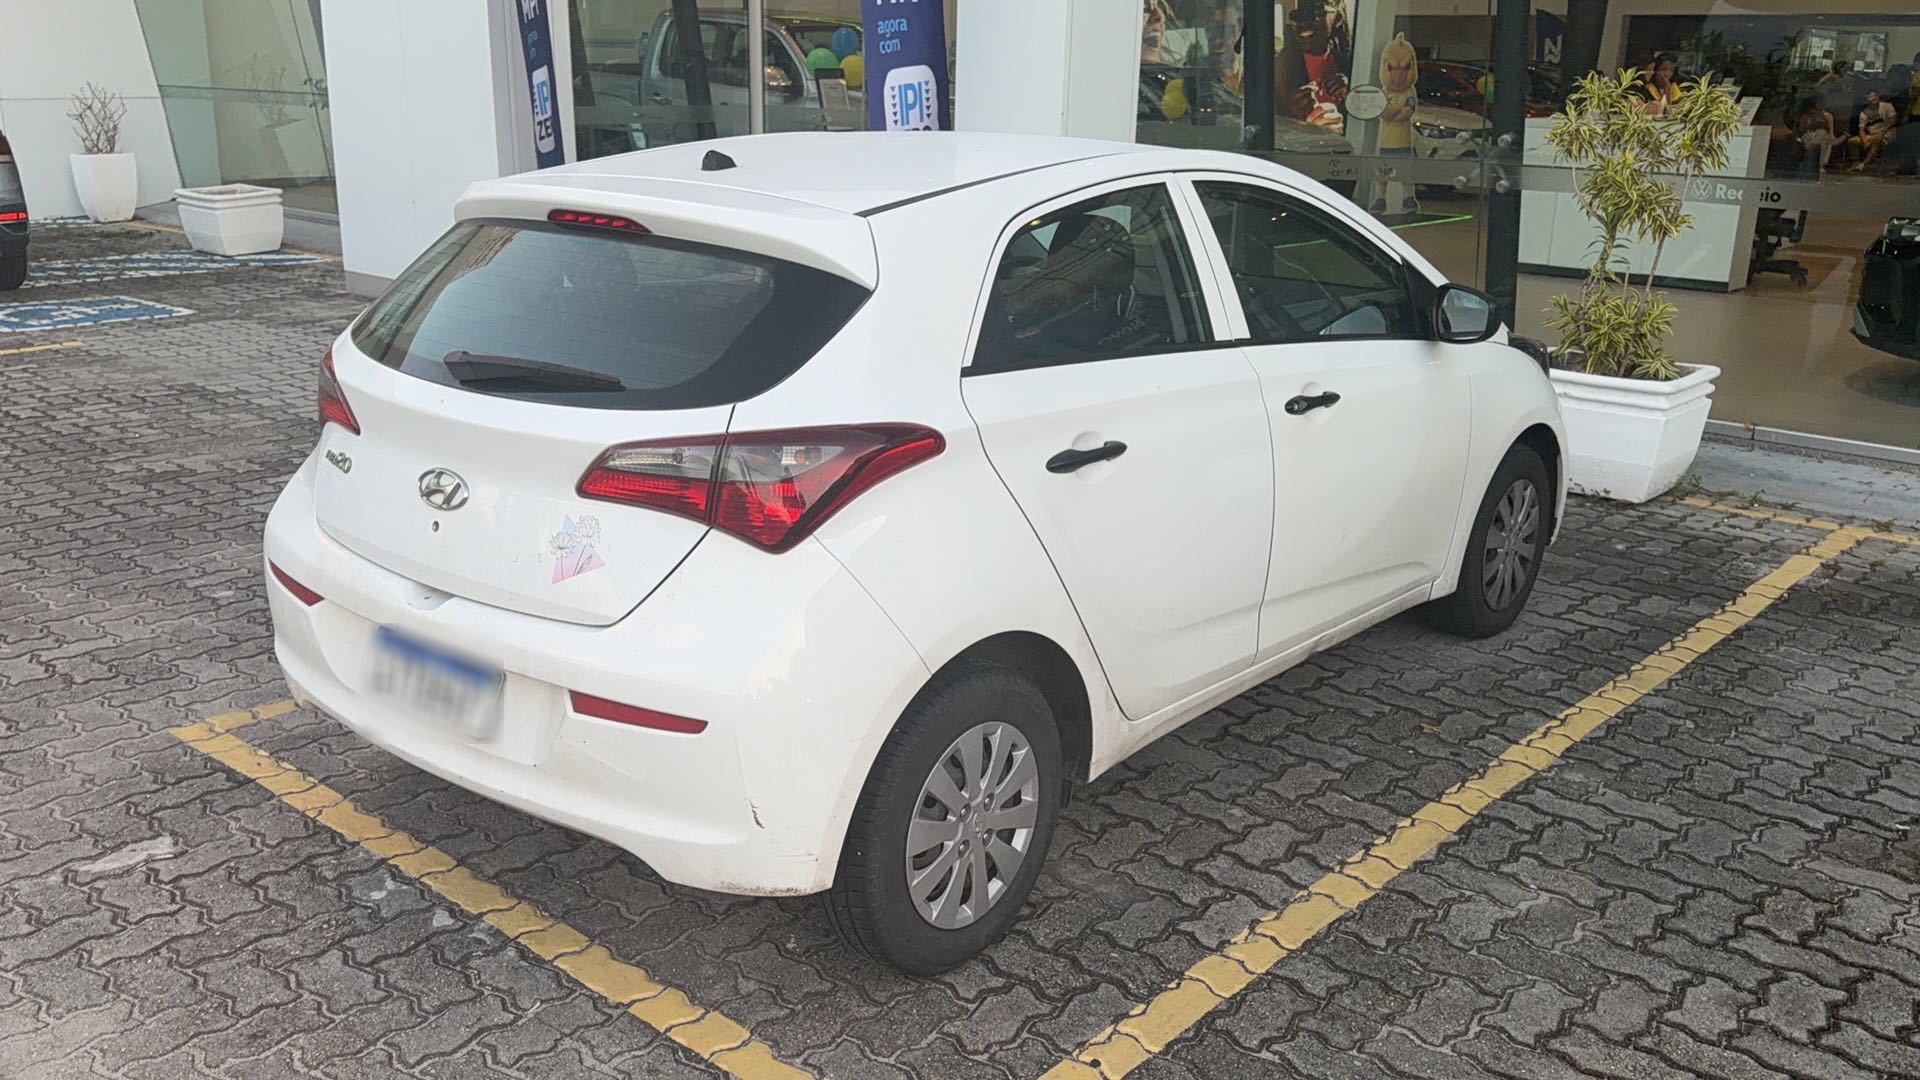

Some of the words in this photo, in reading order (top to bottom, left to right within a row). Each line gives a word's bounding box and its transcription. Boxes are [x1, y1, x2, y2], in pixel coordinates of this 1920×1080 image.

[877, 18, 909, 38] agora
[880, 39, 901, 54] com
[898, 81, 924, 126] IPI
[537, 118, 553, 141] ZE
